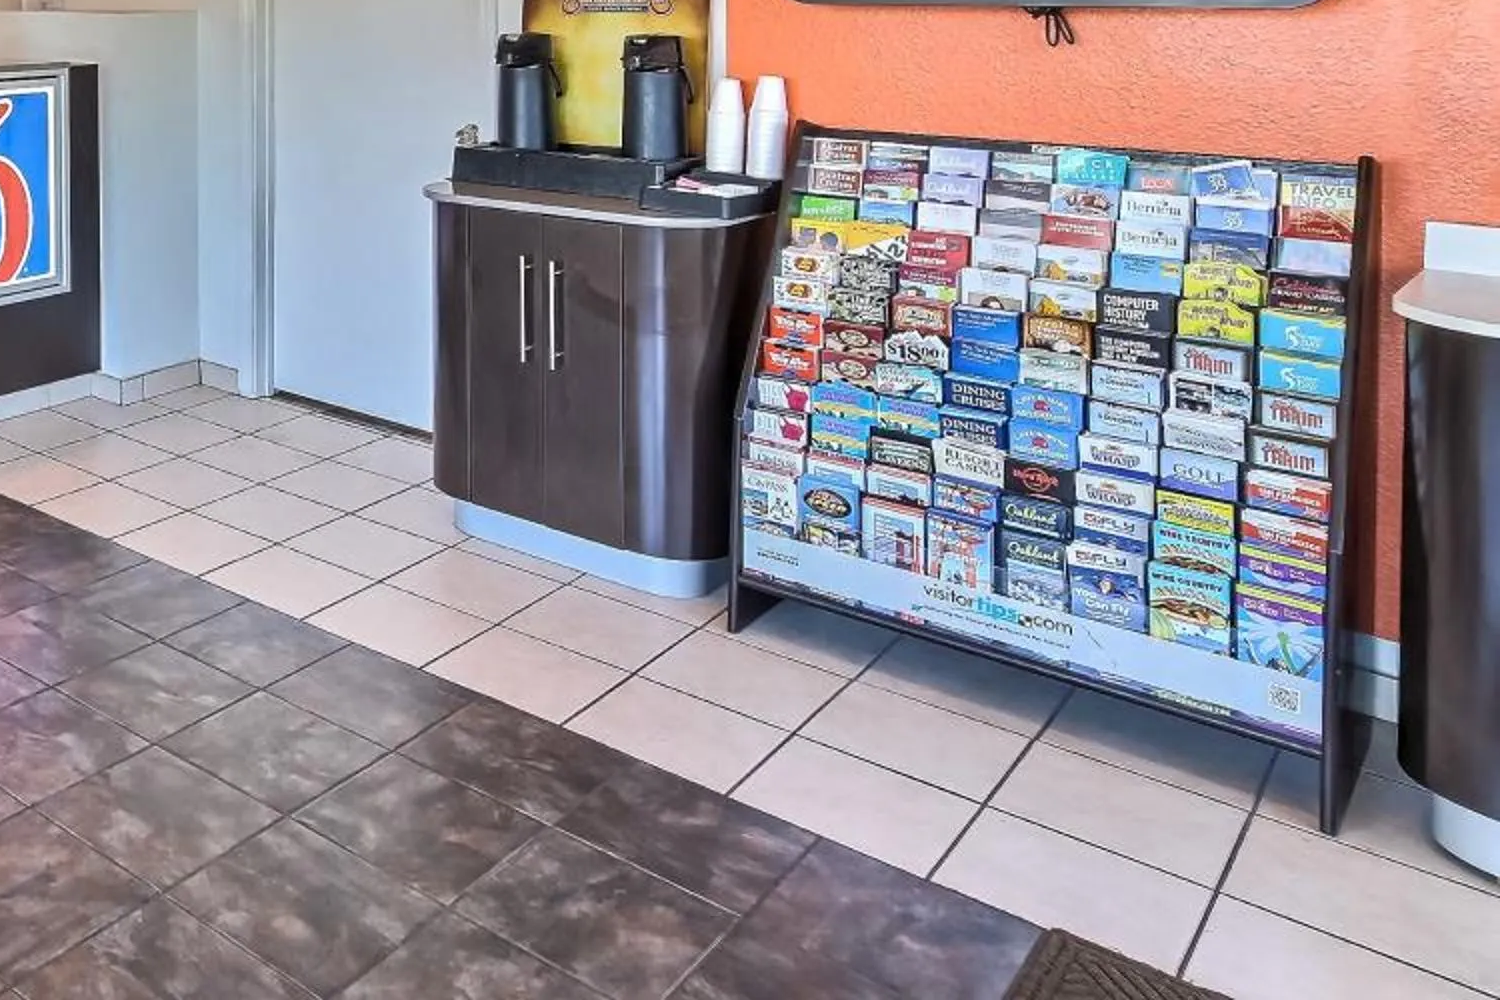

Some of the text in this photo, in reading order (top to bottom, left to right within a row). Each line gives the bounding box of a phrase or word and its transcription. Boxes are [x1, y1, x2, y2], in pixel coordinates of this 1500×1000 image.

[1290, 183, 1355, 199] TRAVEL
[1291, 197, 1338, 209] INFO
[1103, 294, 1160, 311] COMPUTER
[1103, 306, 1147, 321] HISTORY
[953, 382, 1005, 401] DINING
[943, 418, 996, 436] DINING
[945, 448, 1001, 471] RESORT
[945, 459, 1002, 479] CASINO
